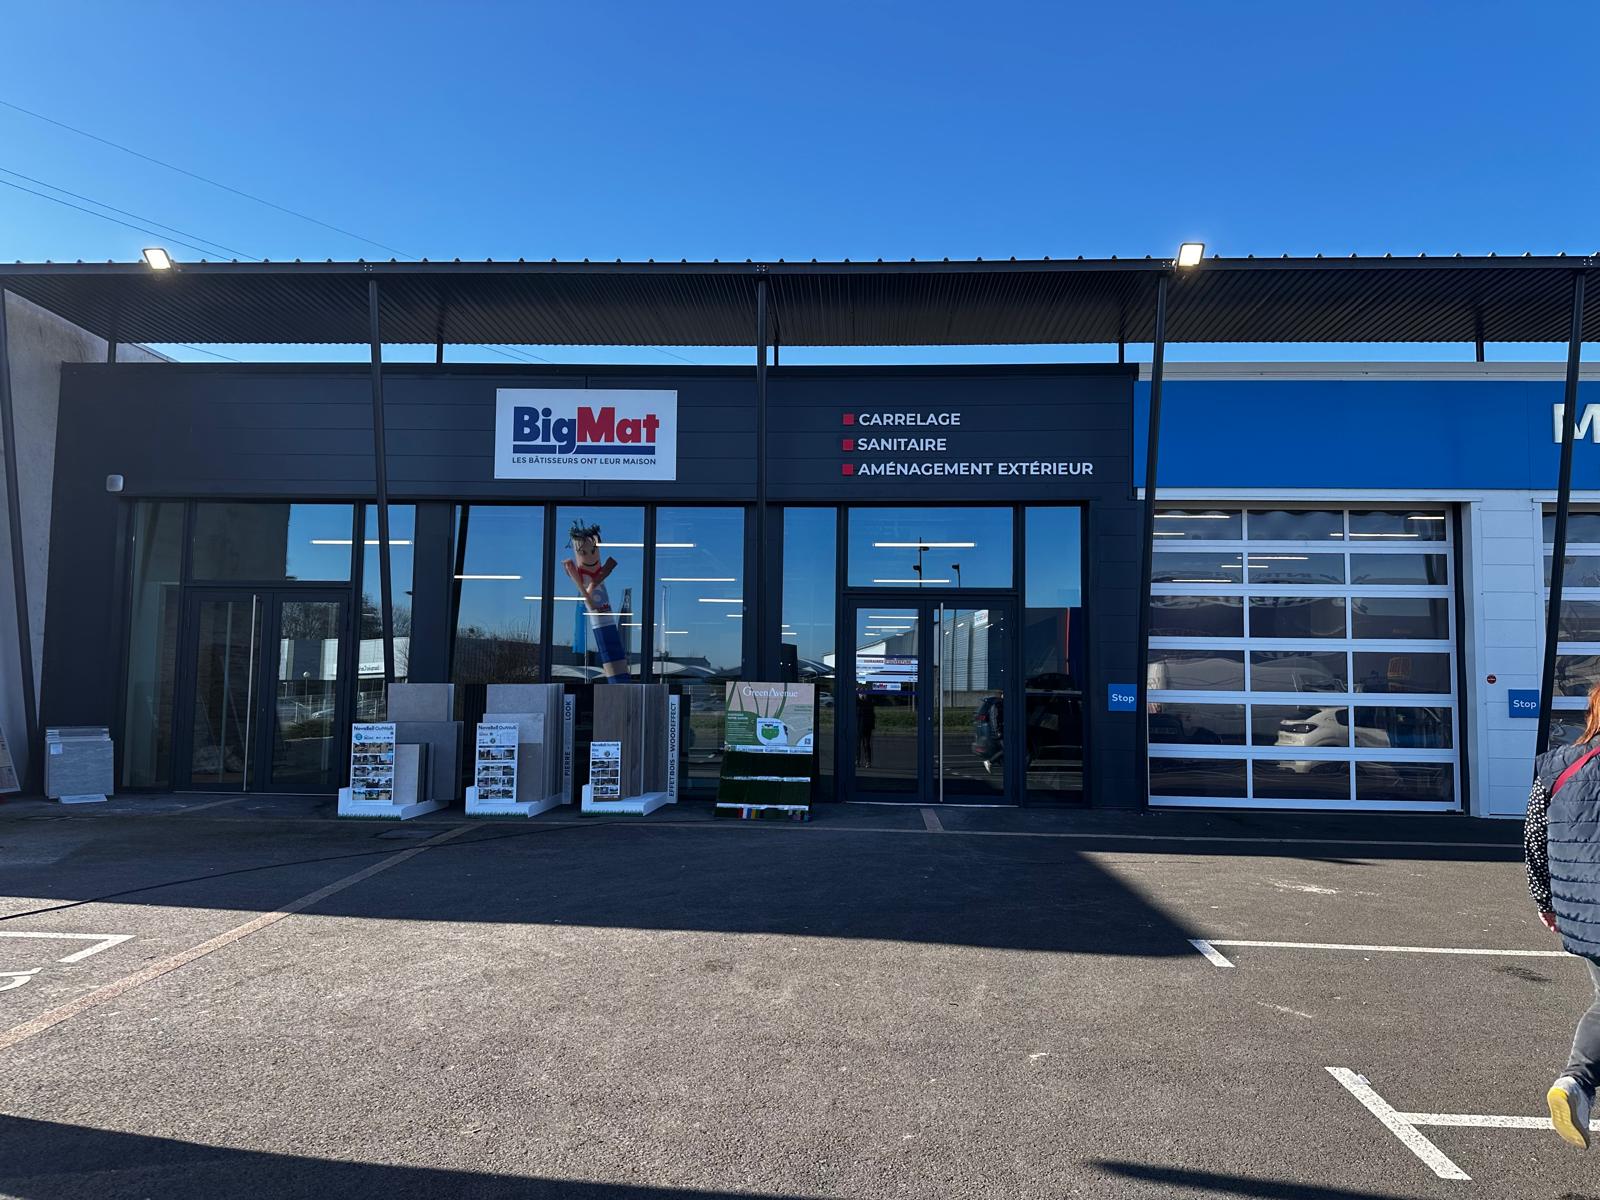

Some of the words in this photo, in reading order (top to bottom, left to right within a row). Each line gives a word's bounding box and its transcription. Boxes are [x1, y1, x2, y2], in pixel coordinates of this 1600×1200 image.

[858, 413, 961, 426] CARRELAGE
[513, 406, 660, 454] BigMat
[857, 438, 947, 451] SANITAIRE
[528, 455, 579, 465] BÂTISSEURS
[580, 457, 598, 465] ONT
[600, 457, 621, 465] LEUR
[858, 461, 993, 476] AMÉNAGEMENT
[998, 460, 1093, 475] EXTÉRIEUR
[1111, 693, 1135, 704] Stop
[1513, 699, 1537, 710] Stop
